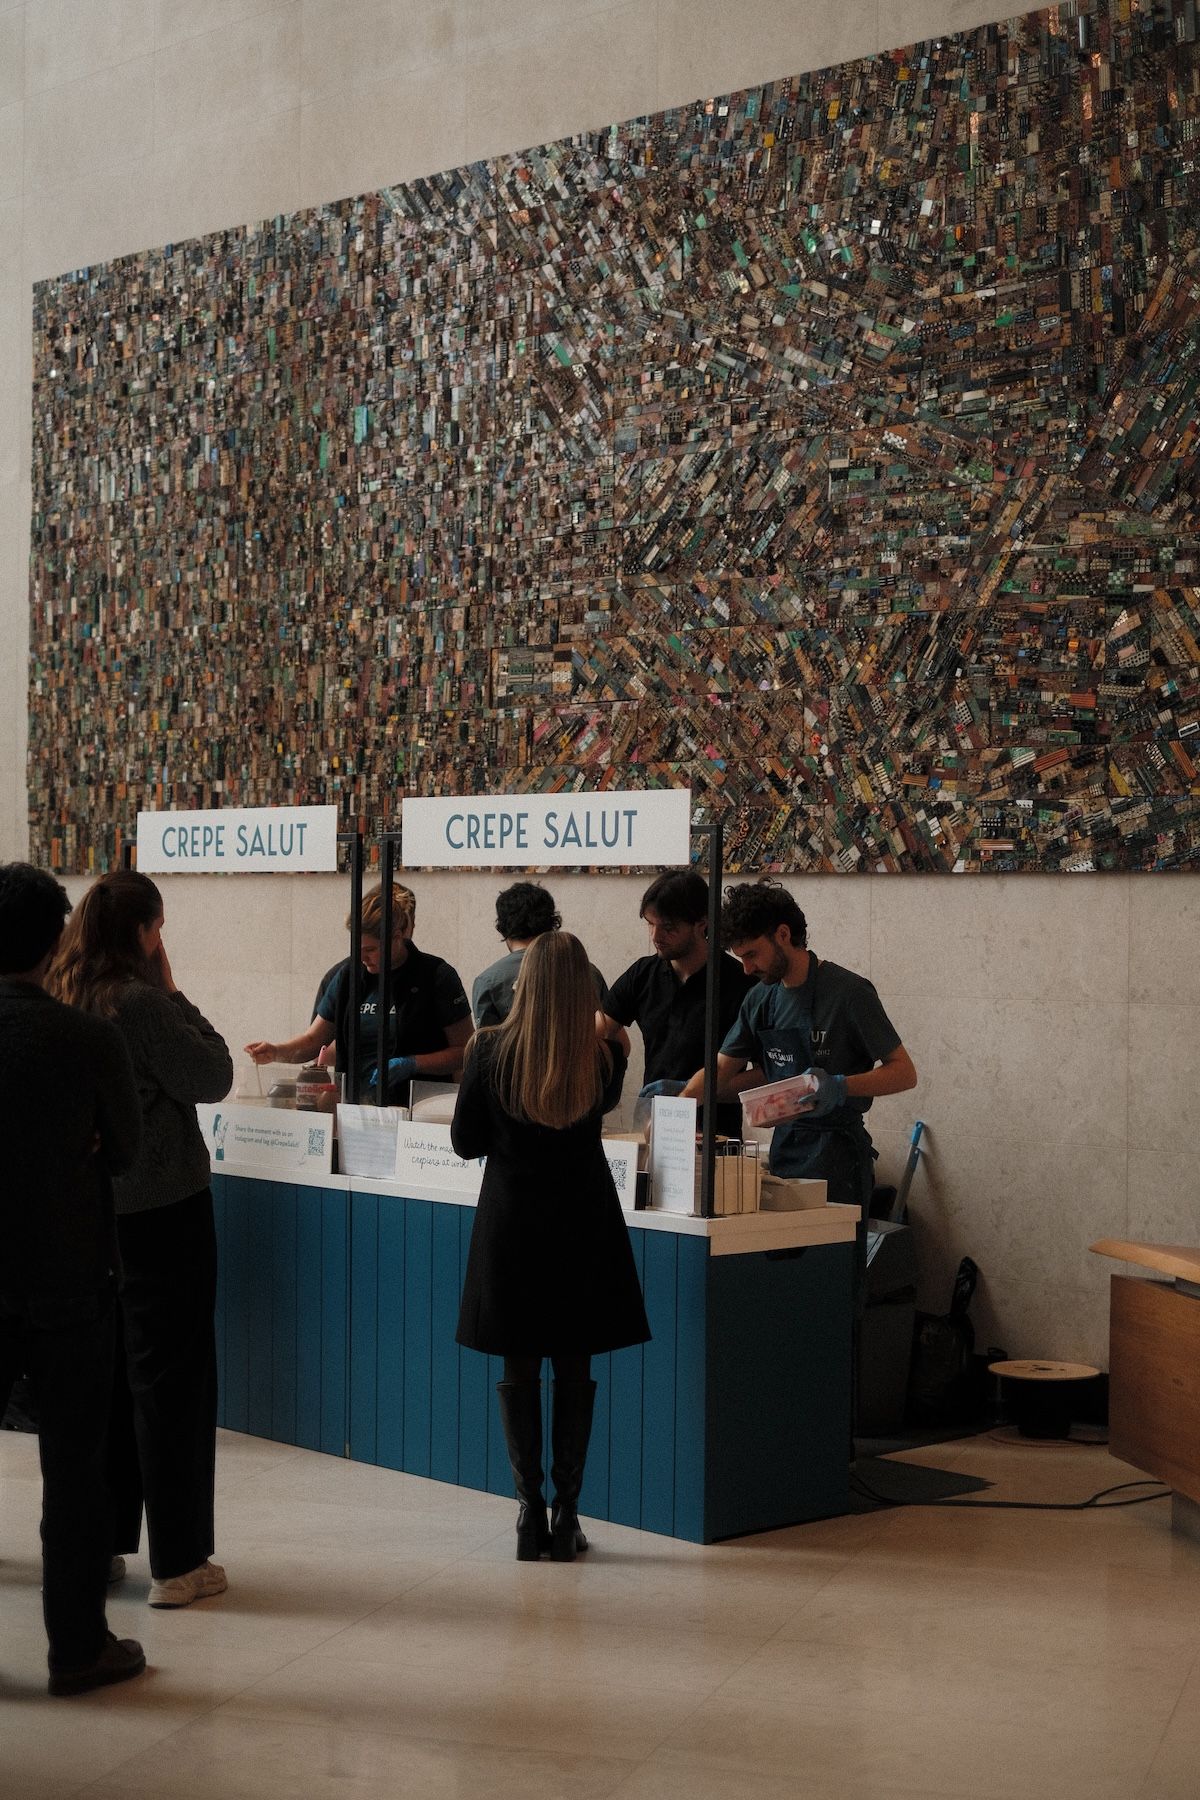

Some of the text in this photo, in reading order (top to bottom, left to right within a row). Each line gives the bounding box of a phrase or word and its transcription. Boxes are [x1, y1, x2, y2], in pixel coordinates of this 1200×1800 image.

[445, 810, 638, 850] CREPE SALUT
[162, 823, 308, 858] CREPE SALUT
[360, 1003, 377, 1014] EPE
[235, 1124, 247, 1133] Share
[255, 1127, 272, 1136] moment
[403, 1137, 426, 1150] Watch
[427, 1142, 438, 1152] the
[411, 1156, 440, 1170] crepiers
